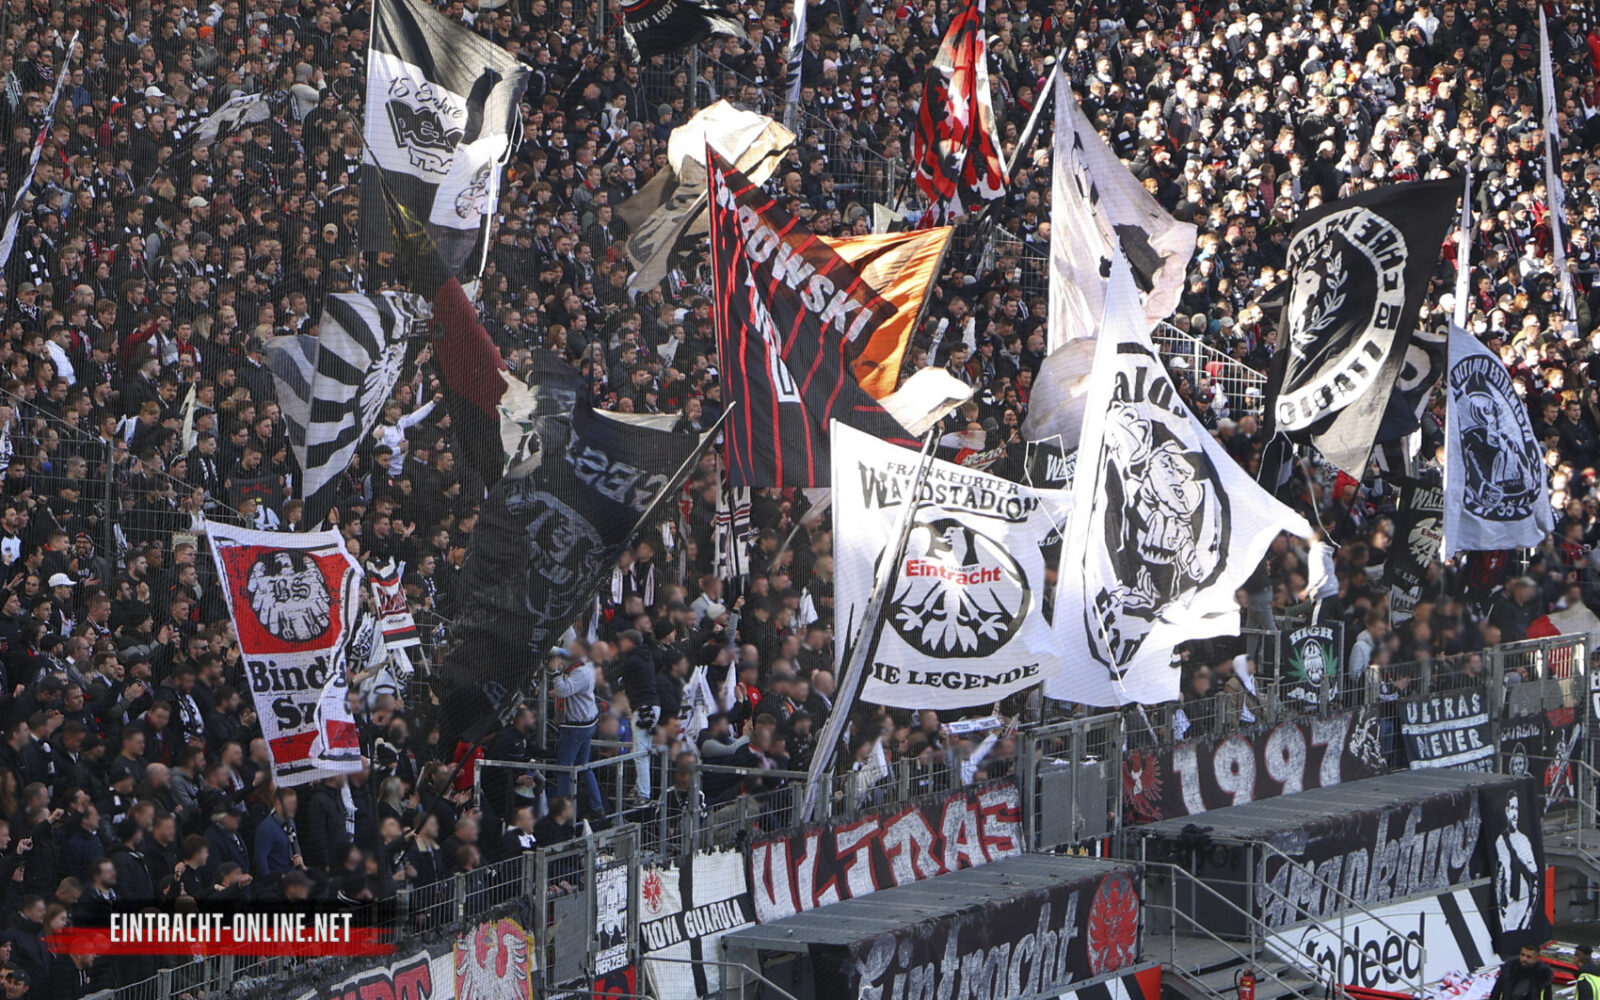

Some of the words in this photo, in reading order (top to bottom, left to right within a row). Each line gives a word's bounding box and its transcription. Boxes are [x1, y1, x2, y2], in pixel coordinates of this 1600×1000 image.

[652, 0, 678, 24] 1997
[858, 461, 1042, 519] WADSTADION
[906, 559, 1002, 585] Eintracht
[1289, 626, 1334, 646] HIGH
[906, 662, 1040, 690] LEGENDE
[1406, 693, 1481, 724] ULTRAS
[1416, 728, 1484, 759] NEVER
[1173, 722, 1352, 814] 1997
[751, 786, 1024, 925] ULTRAS
[1300, 912, 1426, 988] indeed
